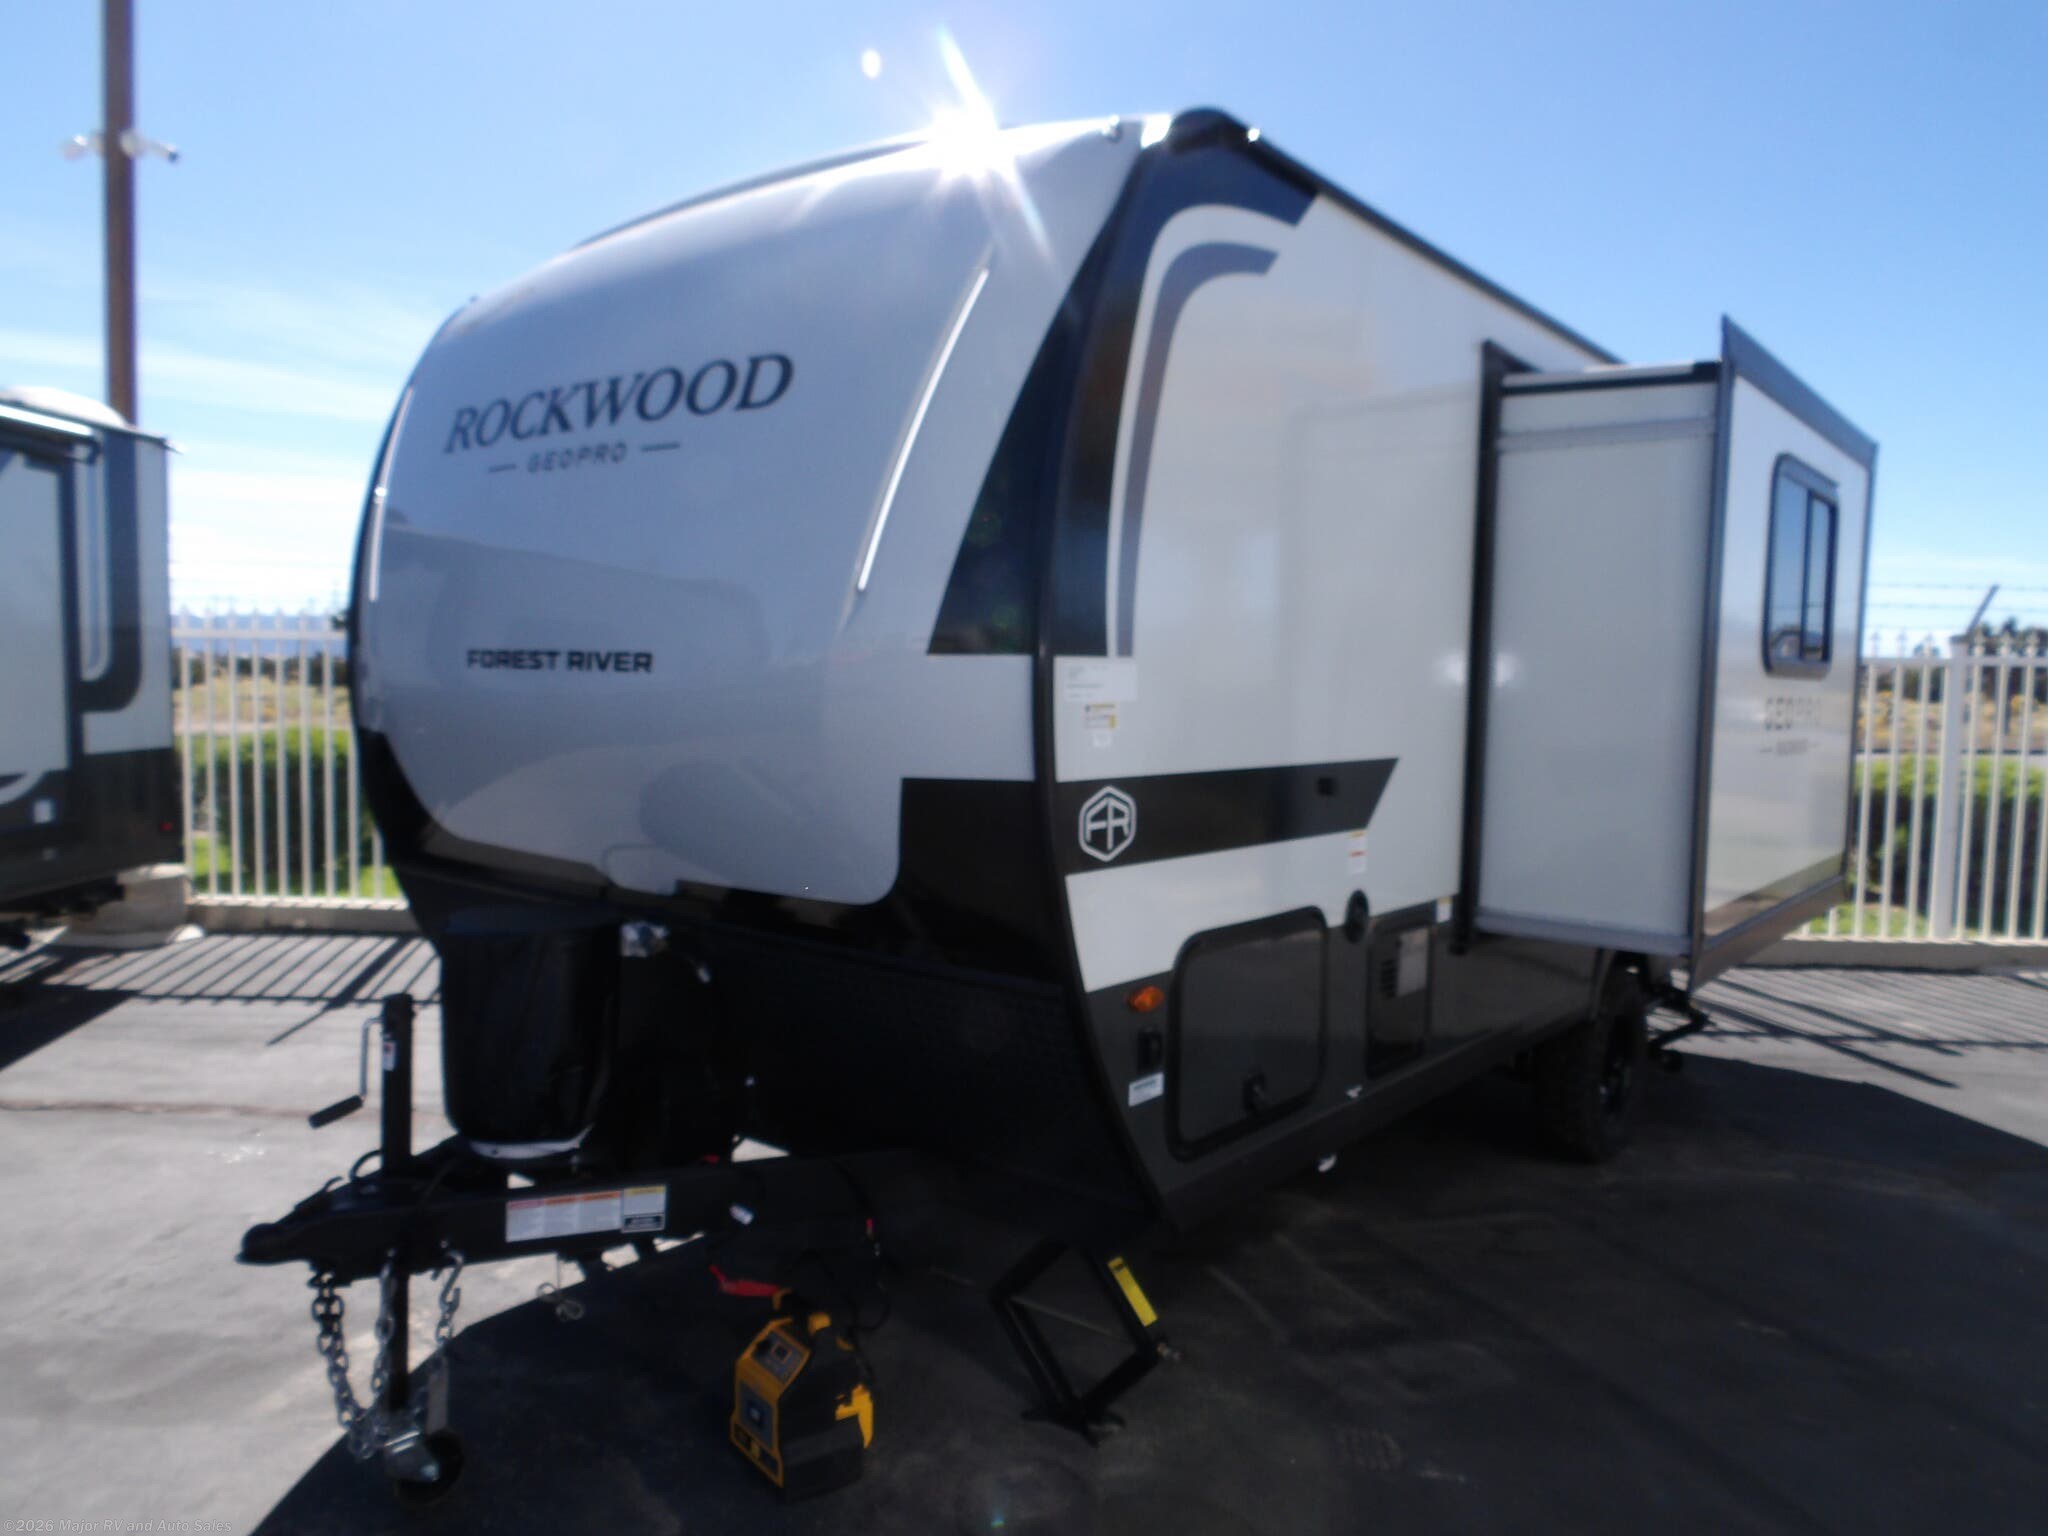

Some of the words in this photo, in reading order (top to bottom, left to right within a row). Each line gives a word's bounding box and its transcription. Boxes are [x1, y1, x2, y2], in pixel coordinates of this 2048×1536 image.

[444, 352, 794, 453] ROCKWOOD
[527, 442, 628, 473] GEOPRO
[467, 650, 560, 670] FOREST
[567, 651, 653, 673] RIVER
